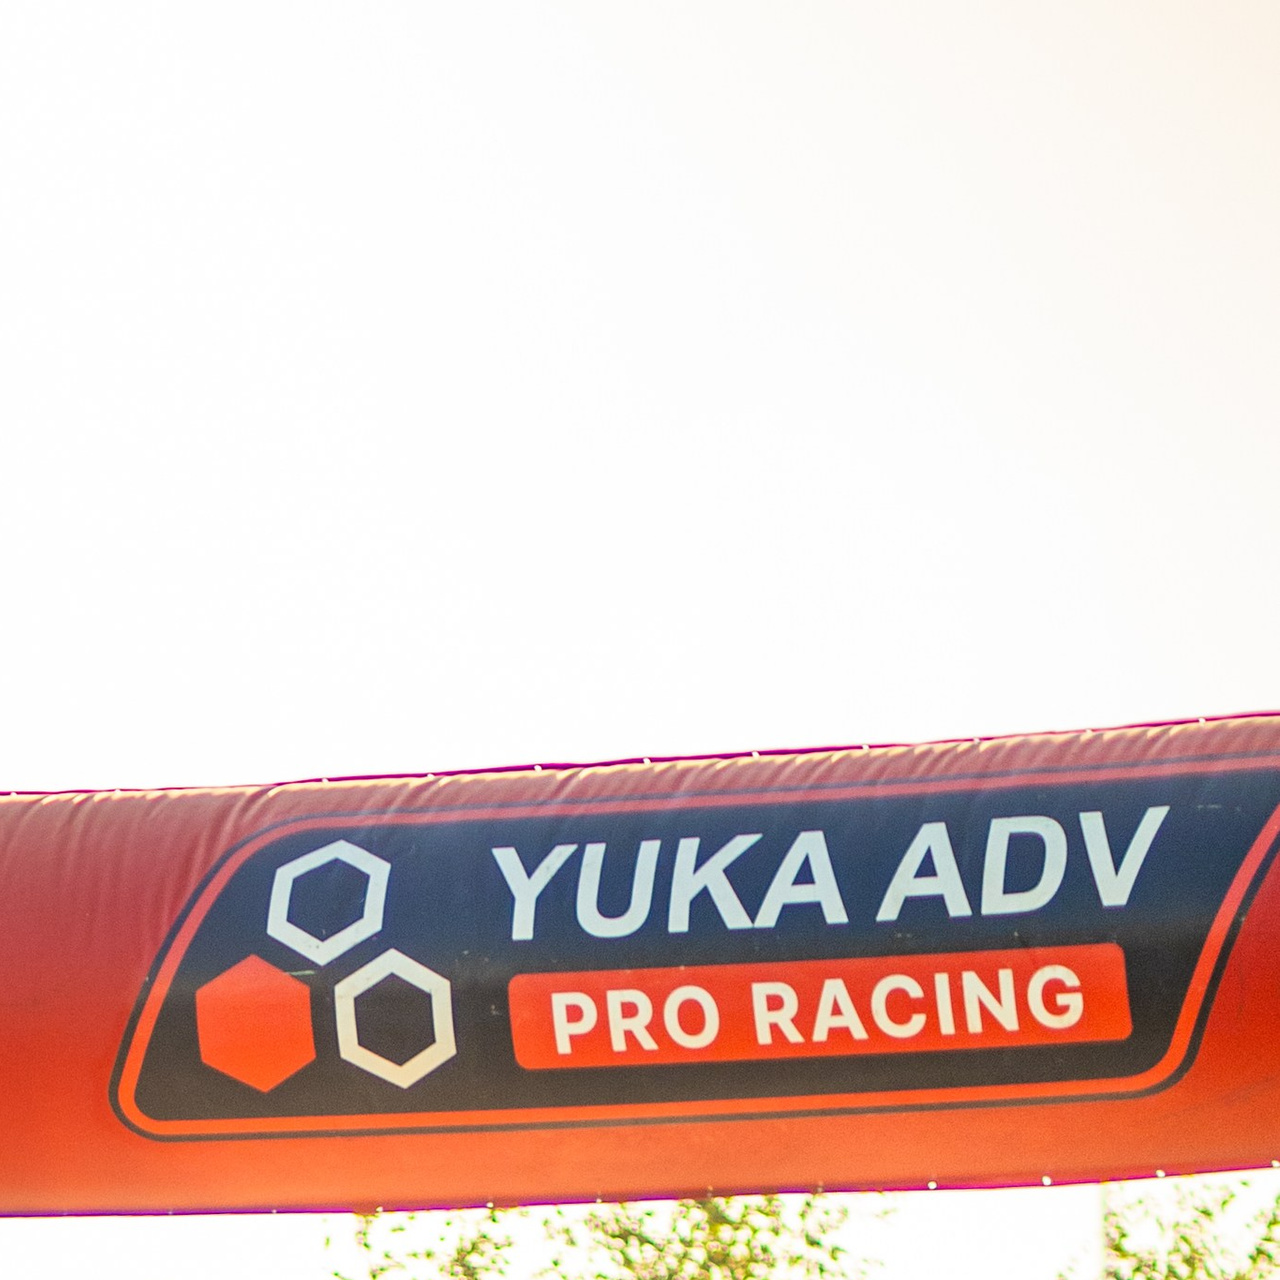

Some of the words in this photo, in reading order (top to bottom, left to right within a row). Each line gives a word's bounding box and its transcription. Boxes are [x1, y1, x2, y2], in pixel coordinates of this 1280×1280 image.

[492, 832, 850, 942] YUKA
[876, 805, 1170, 922] ADV
[550, 982, 720, 1056] PRO
[754, 964, 1084, 1046] RACING
